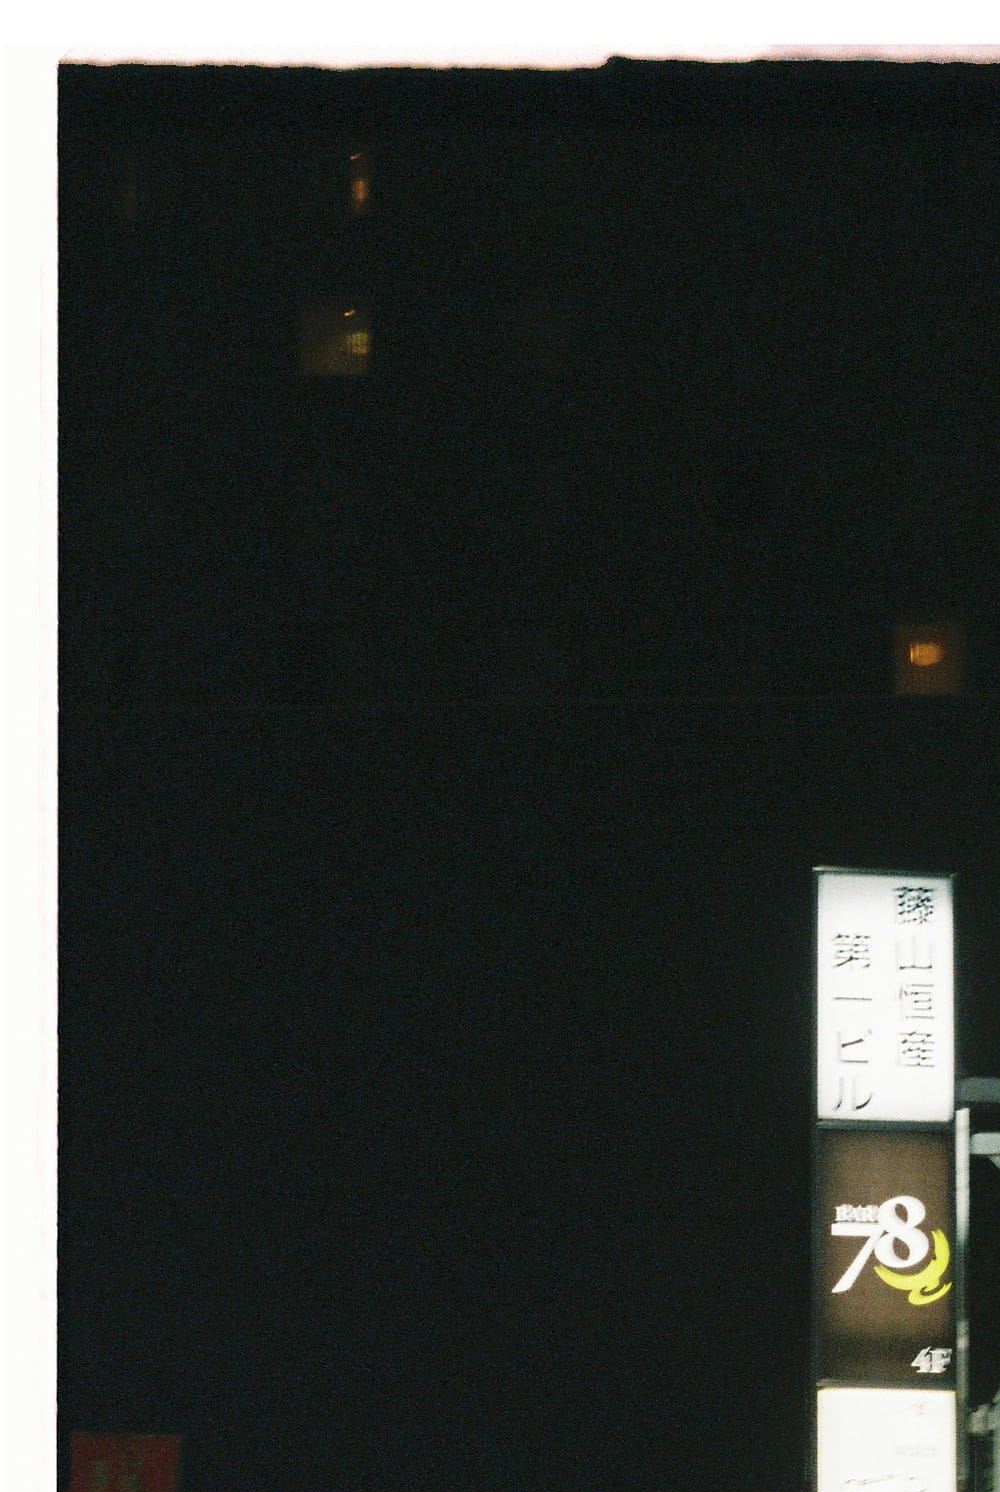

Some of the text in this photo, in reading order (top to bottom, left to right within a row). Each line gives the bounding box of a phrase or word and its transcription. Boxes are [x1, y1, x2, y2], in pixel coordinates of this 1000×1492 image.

[831, 933, 873, 1111] 第一ビル
[831, 1195, 930, 1294] 78
[911, 1346, 952, 1374] 4F
